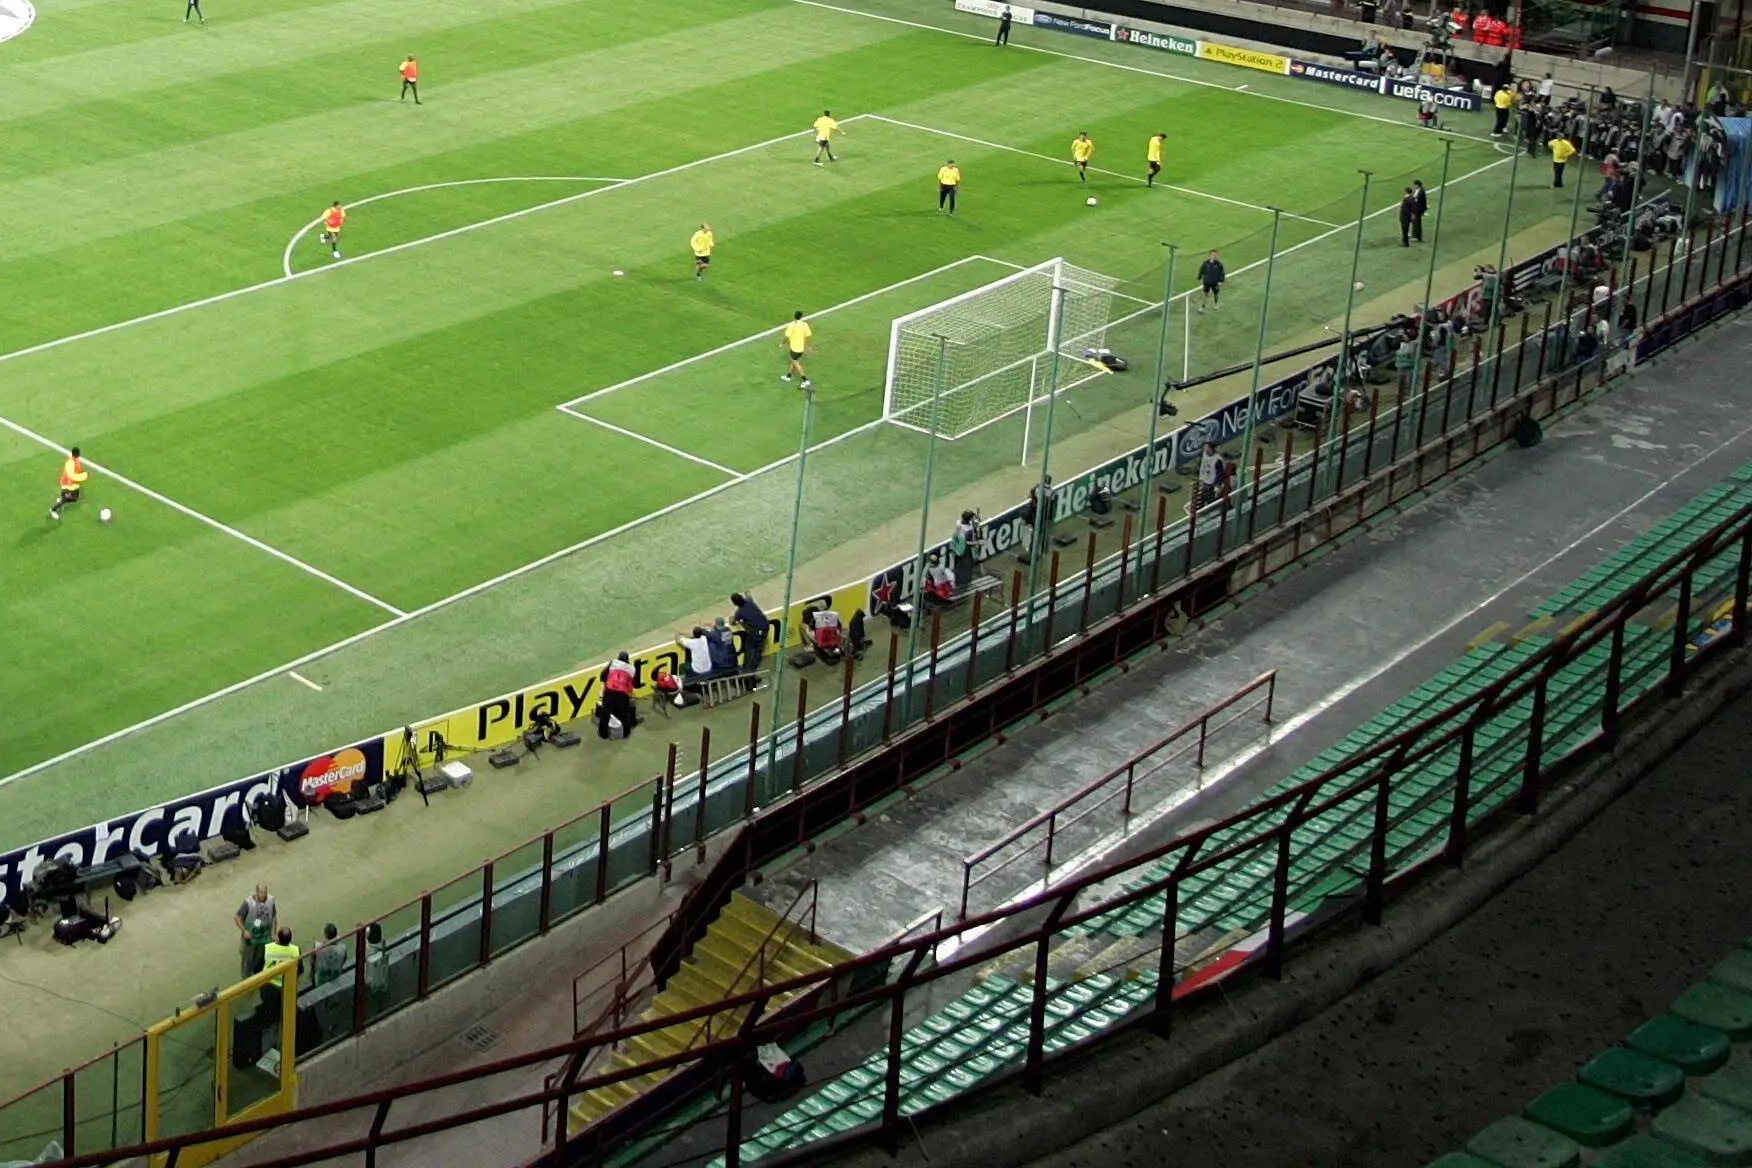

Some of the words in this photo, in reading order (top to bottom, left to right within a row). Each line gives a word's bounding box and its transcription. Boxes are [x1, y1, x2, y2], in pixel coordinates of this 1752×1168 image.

[1130, 31, 1194, 53] Heineken
[1216, 47, 1272, 67] PlayStation
[1305, 66, 1378, 89] MasterCard
[1393, 83, 1472, 110] uefa.com
[302, 760, 365, 793] MasterCard
